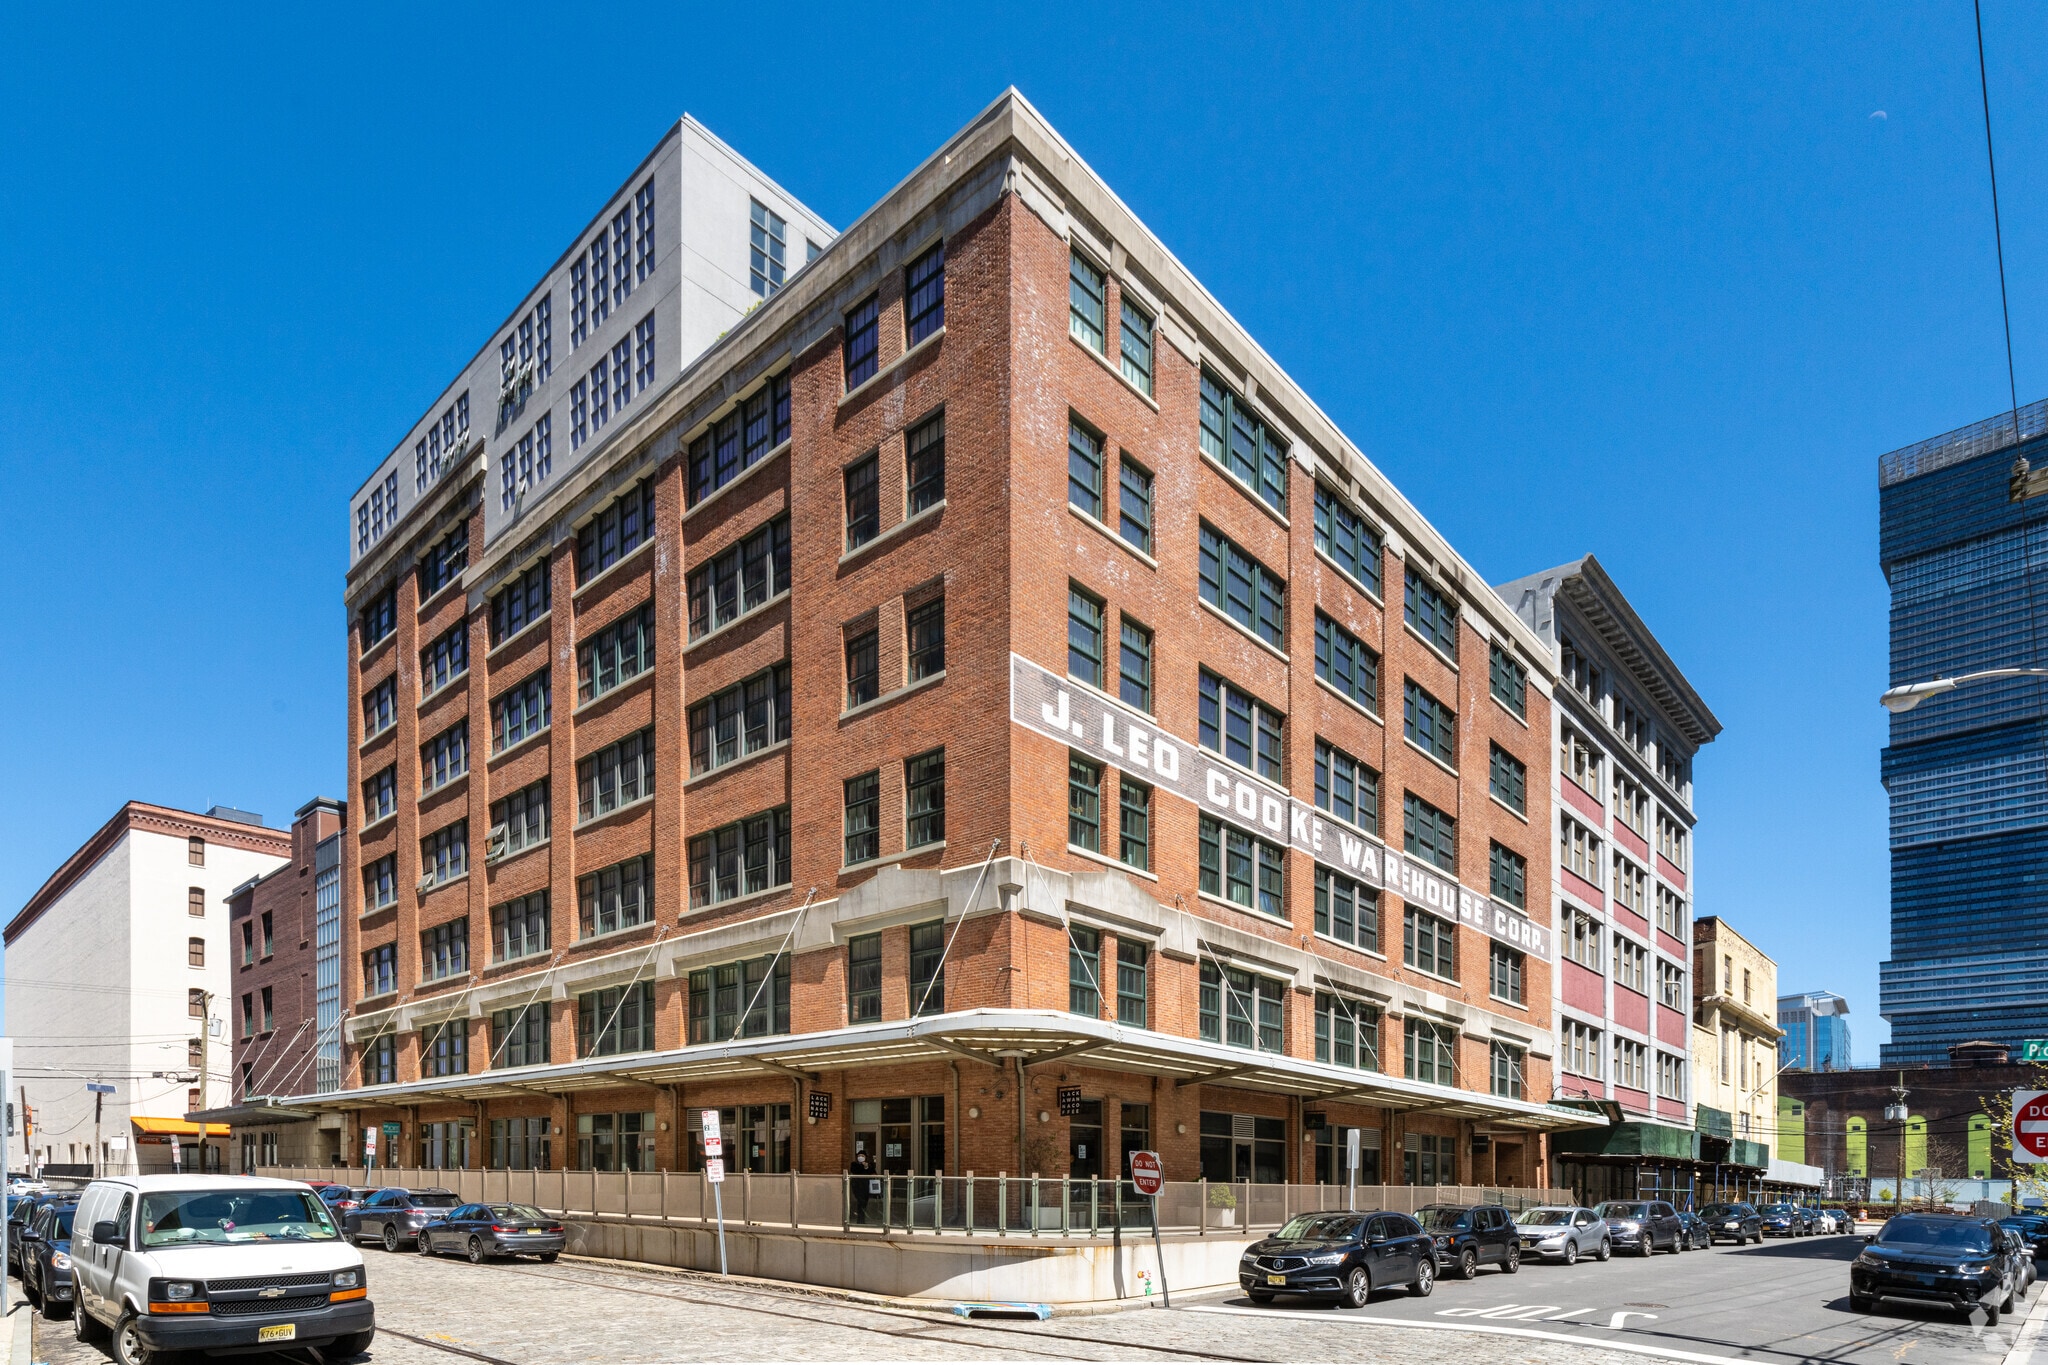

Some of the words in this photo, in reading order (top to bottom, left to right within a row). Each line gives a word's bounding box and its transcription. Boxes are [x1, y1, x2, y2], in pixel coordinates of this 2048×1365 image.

[1041, 689, 1083, 739] J.
[1103, 712, 1179, 781] LEO
[1206, 767, 1323, 853] COOKE
[1339, 832, 1484, 925] WAREHOUSE
[1494, 909, 1545, 954] CORP.
[1135, 1159, 1143, 1167] DO
[1139, 1178, 1156, 1187] ENTER
